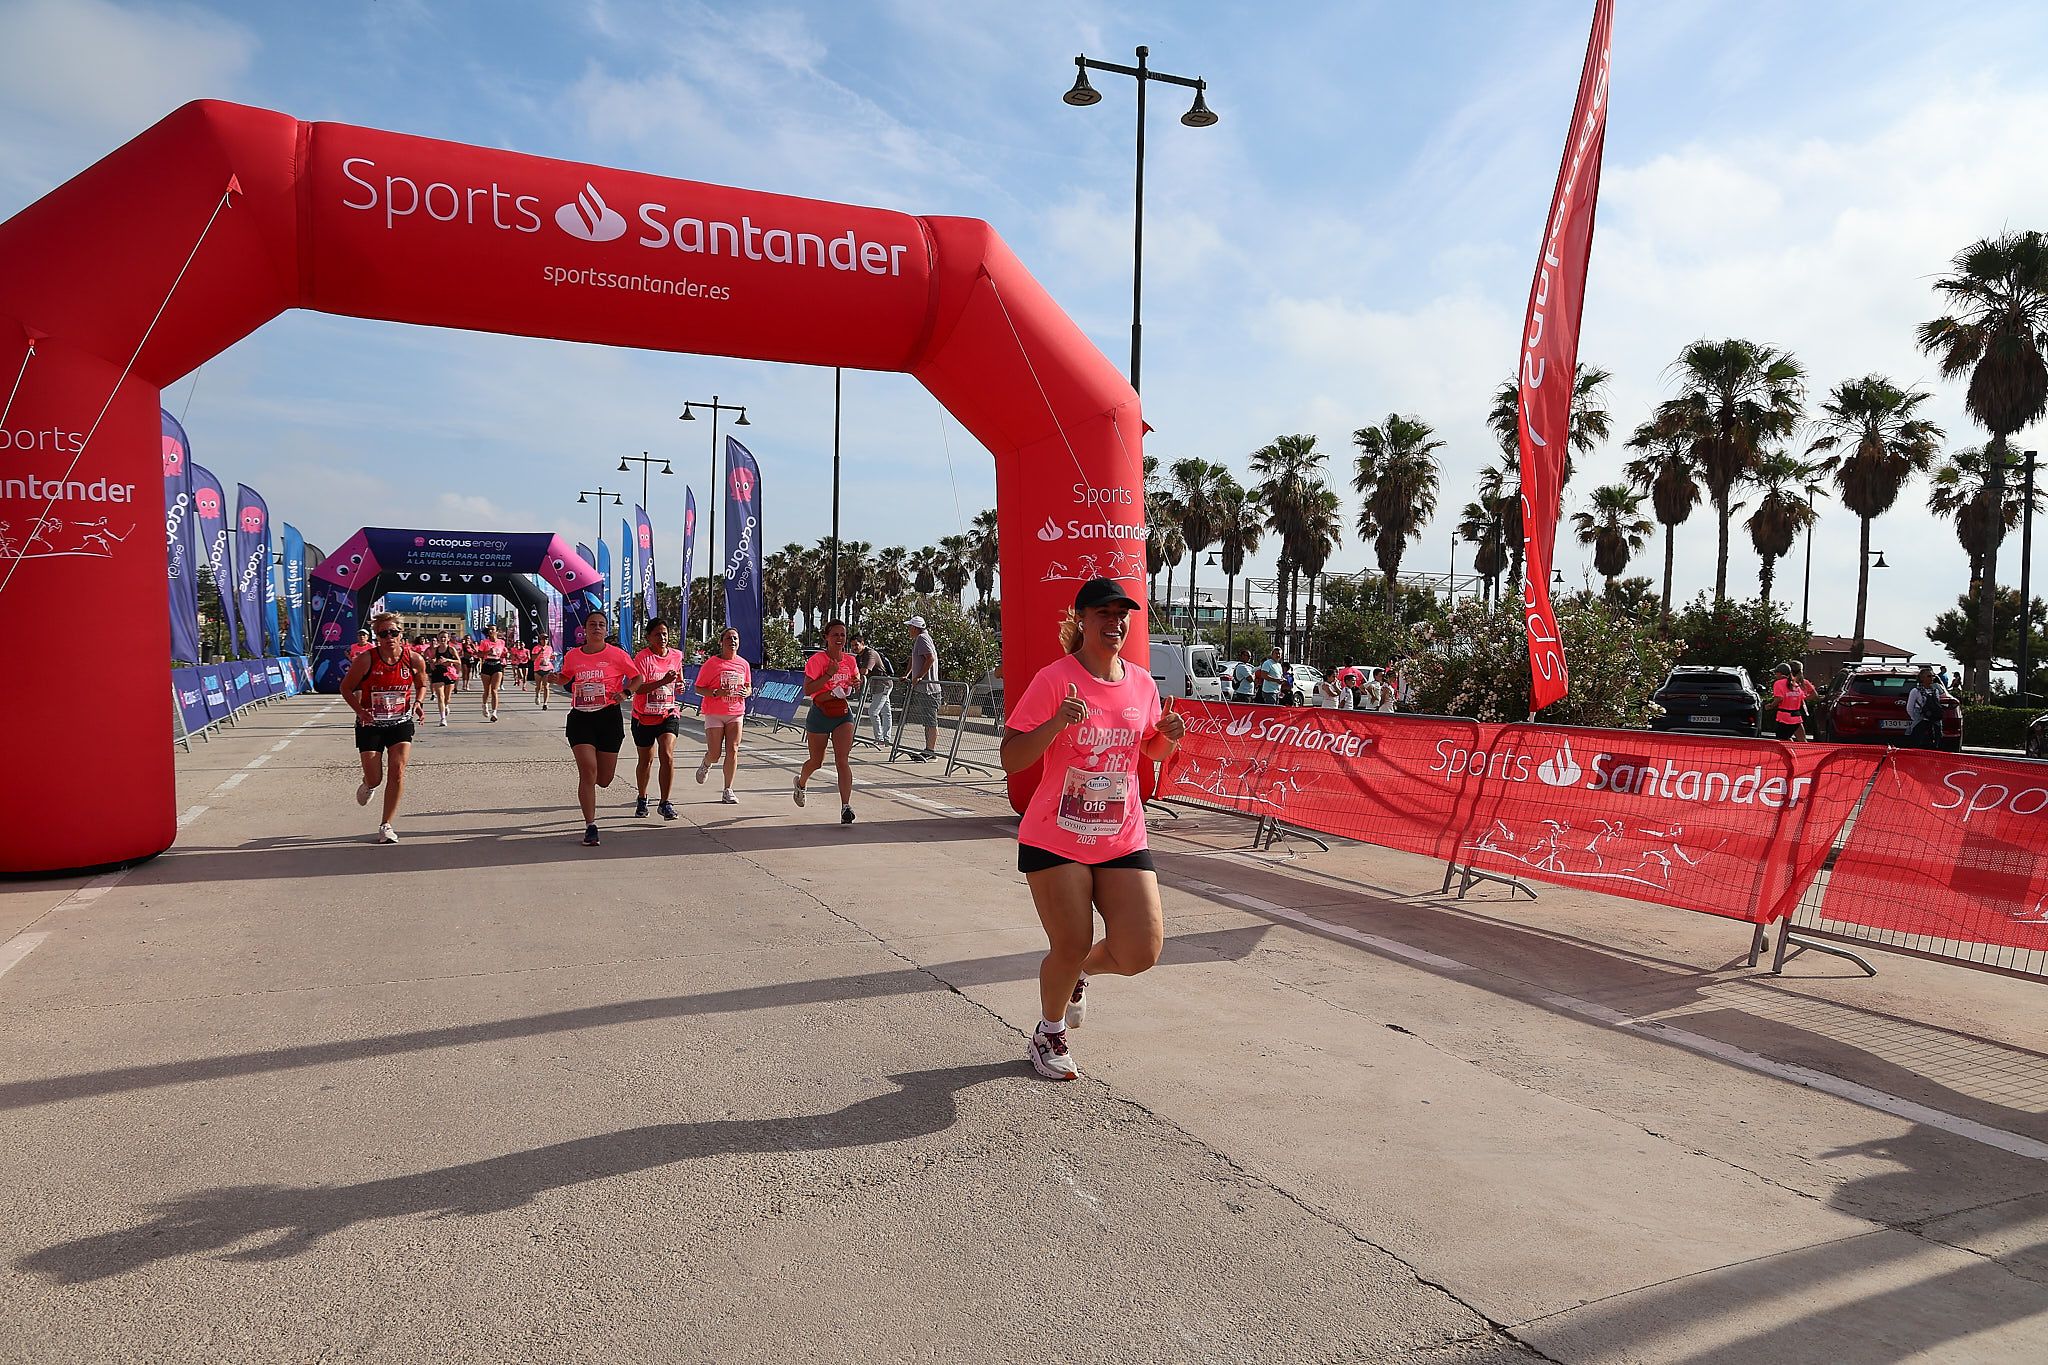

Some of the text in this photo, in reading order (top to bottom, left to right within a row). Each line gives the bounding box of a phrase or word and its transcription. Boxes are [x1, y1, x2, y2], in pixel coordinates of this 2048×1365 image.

[341, 157, 907, 276] Sports Santander
[543, 263, 731, 301] sportssantander.es
[0, 474, 136, 503] ntander
[1072, 483, 1133, 508] Sports
[428, 538, 508, 551] octopus energy
[420, 550, 455, 559] ENERGÍA
[396, 572, 493, 583] VOLVO
[411, 595, 448, 609] Marlene
[1087, 707, 1103, 716] SHO
[1077, 726, 1136, 747] CARRERA
[1250, 716, 1375, 759] Santander
[1429, 738, 1812, 809] Sports Santander
[1083, 800, 1107, 812] 016
[1064, 820, 1087, 831] OYSHO
[1076, 834, 1097, 845] 2026
